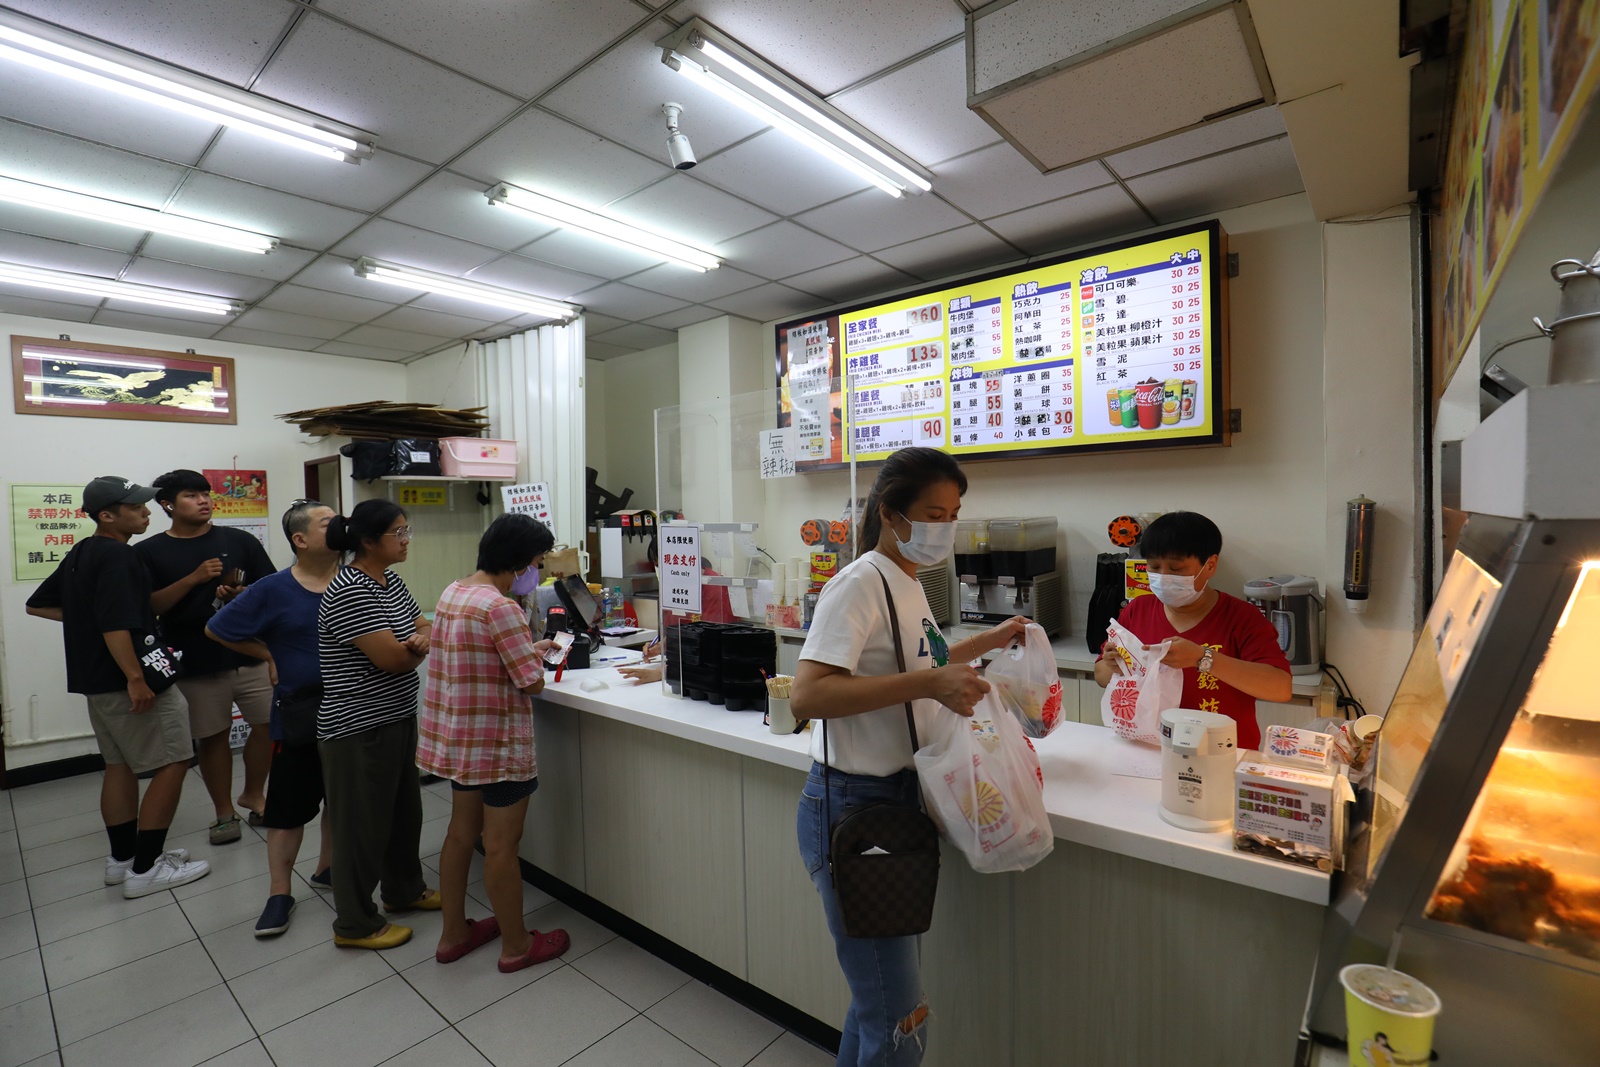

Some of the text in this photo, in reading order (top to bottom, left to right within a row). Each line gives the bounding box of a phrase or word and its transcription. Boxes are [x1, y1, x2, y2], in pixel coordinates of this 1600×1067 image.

[1082, 249, 1199, 283] 冷飲 大 中
[1095, 266, 1199, 292] 可口可樂 30 25
[1014, 282, 1038, 298] 熱飲
[1096, 282, 1199, 307] 雪碧 30 25
[1014, 297, 1040, 308] 巧克力
[950, 311, 974, 322] 牛肉堡
[1015, 310, 1041, 321] 阿華田
[1096, 298, 1200, 323] 芬達 30 25
[849, 318, 877, 333] 全家餐
[911, 306, 938, 325] 360
[1096, 314, 1200, 338] 美粒果 柳橙汁 30 25
[951, 324, 974, 335] 雞肉堡
[1015, 322, 1041, 333] 紅茶
[1015, 335, 1042, 345] 熱咖啡
[1096, 330, 1200, 352] 美粒果 蘋果汁 30 25
[849, 345, 938, 369] 炸雞餐 135
[951, 350, 974, 361] 豬肉堡
[1096, 345, 1200, 367] 雪泥 30 25
[952, 366, 973, 380] 炸物
[1014, 371, 1050, 383] 洋蔥圈
[1097, 361, 1201, 381] 紅茶 30 25
[953, 382, 977, 392] 雞塊
[987, 380, 999, 391] 55
[1014, 386, 1050, 397] 薯餅
[902, 391, 919, 402] 135
[923, 388, 941, 399] 130
[953, 396, 1000, 409] 雞腿 55
[1014, 400, 1050, 411] 薯球
[954, 416, 977, 426] 雞翅
[988, 413, 1001, 426] 40
[1055, 411, 1072, 424] 30
[924, 420, 940, 438] 90
[1015, 428, 1050, 438] 小餐包
[769, 433, 784, 454] 無
[954, 434, 978, 443] 薯條
[763, 457, 794, 477] 辣椒
[43, 494, 72, 504] 本店
[28, 508, 87, 519] 禁帶外食
[44, 534, 74, 546] 內用
[667, 536, 693, 544] 本店限使用
[664, 554, 696, 566] 現金支付
[918, 638, 928, 657] L
[141, 648, 165, 666] JUST
[151, 658, 170, 671] DO
[161, 666, 176, 678] IT.
